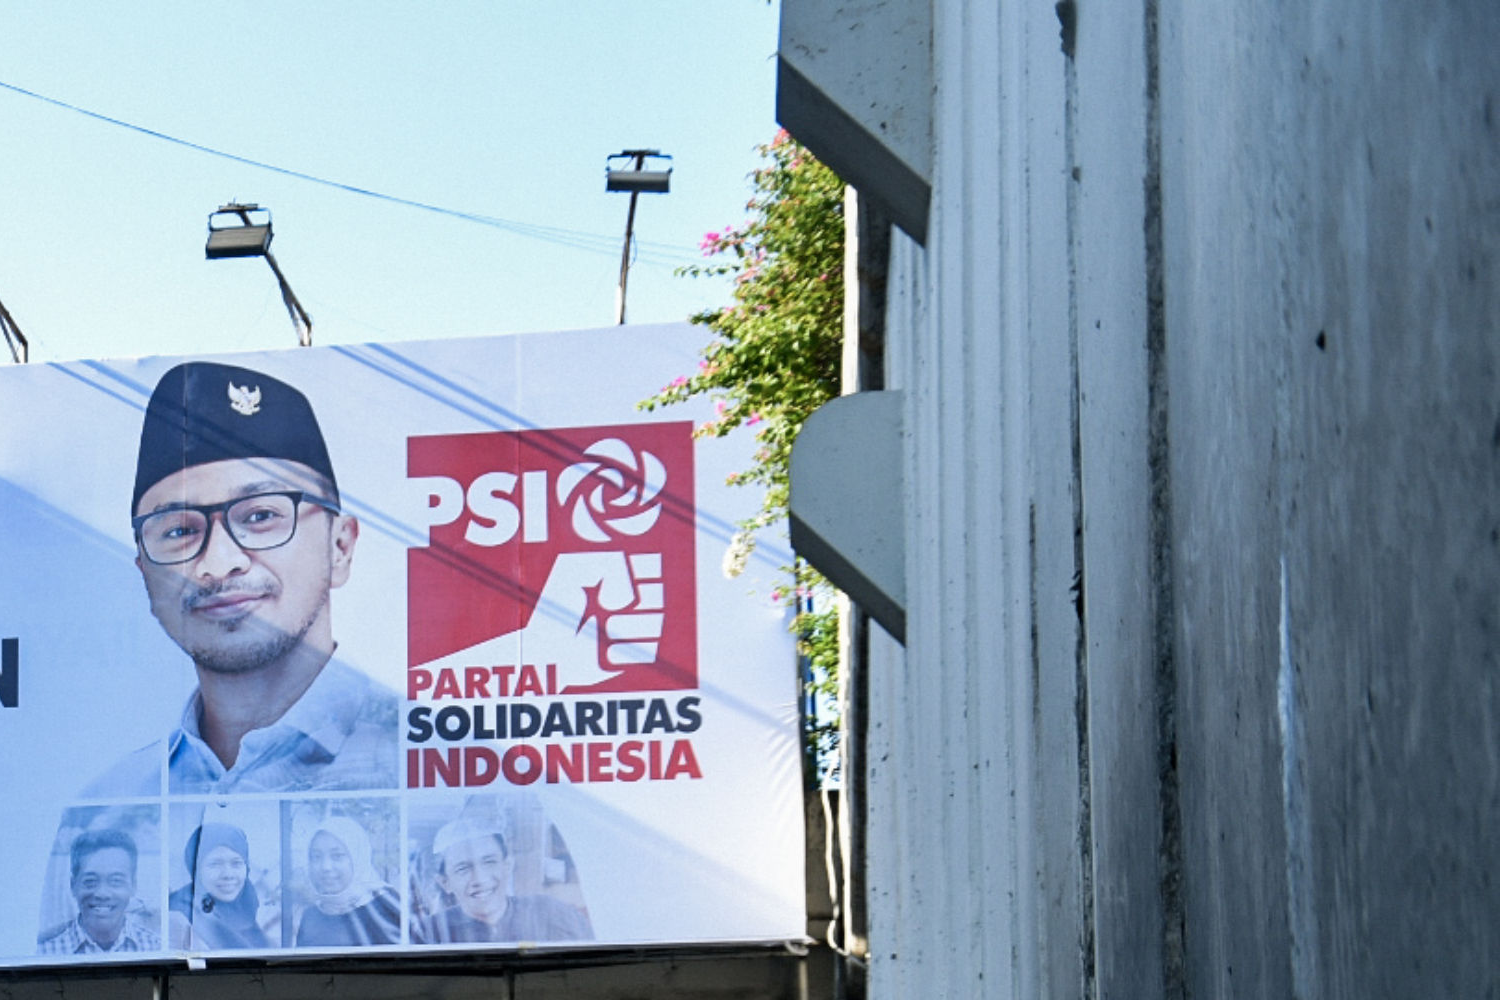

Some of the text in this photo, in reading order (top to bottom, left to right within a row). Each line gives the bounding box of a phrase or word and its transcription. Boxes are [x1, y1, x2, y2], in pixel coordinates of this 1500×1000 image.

[407, 469, 548, 547] PSI
[407, 663, 560, 700] PARTAI
[407, 697, 702, 743] SOLIDARITAS
[407, 739, 703, 789] INDONESIA
